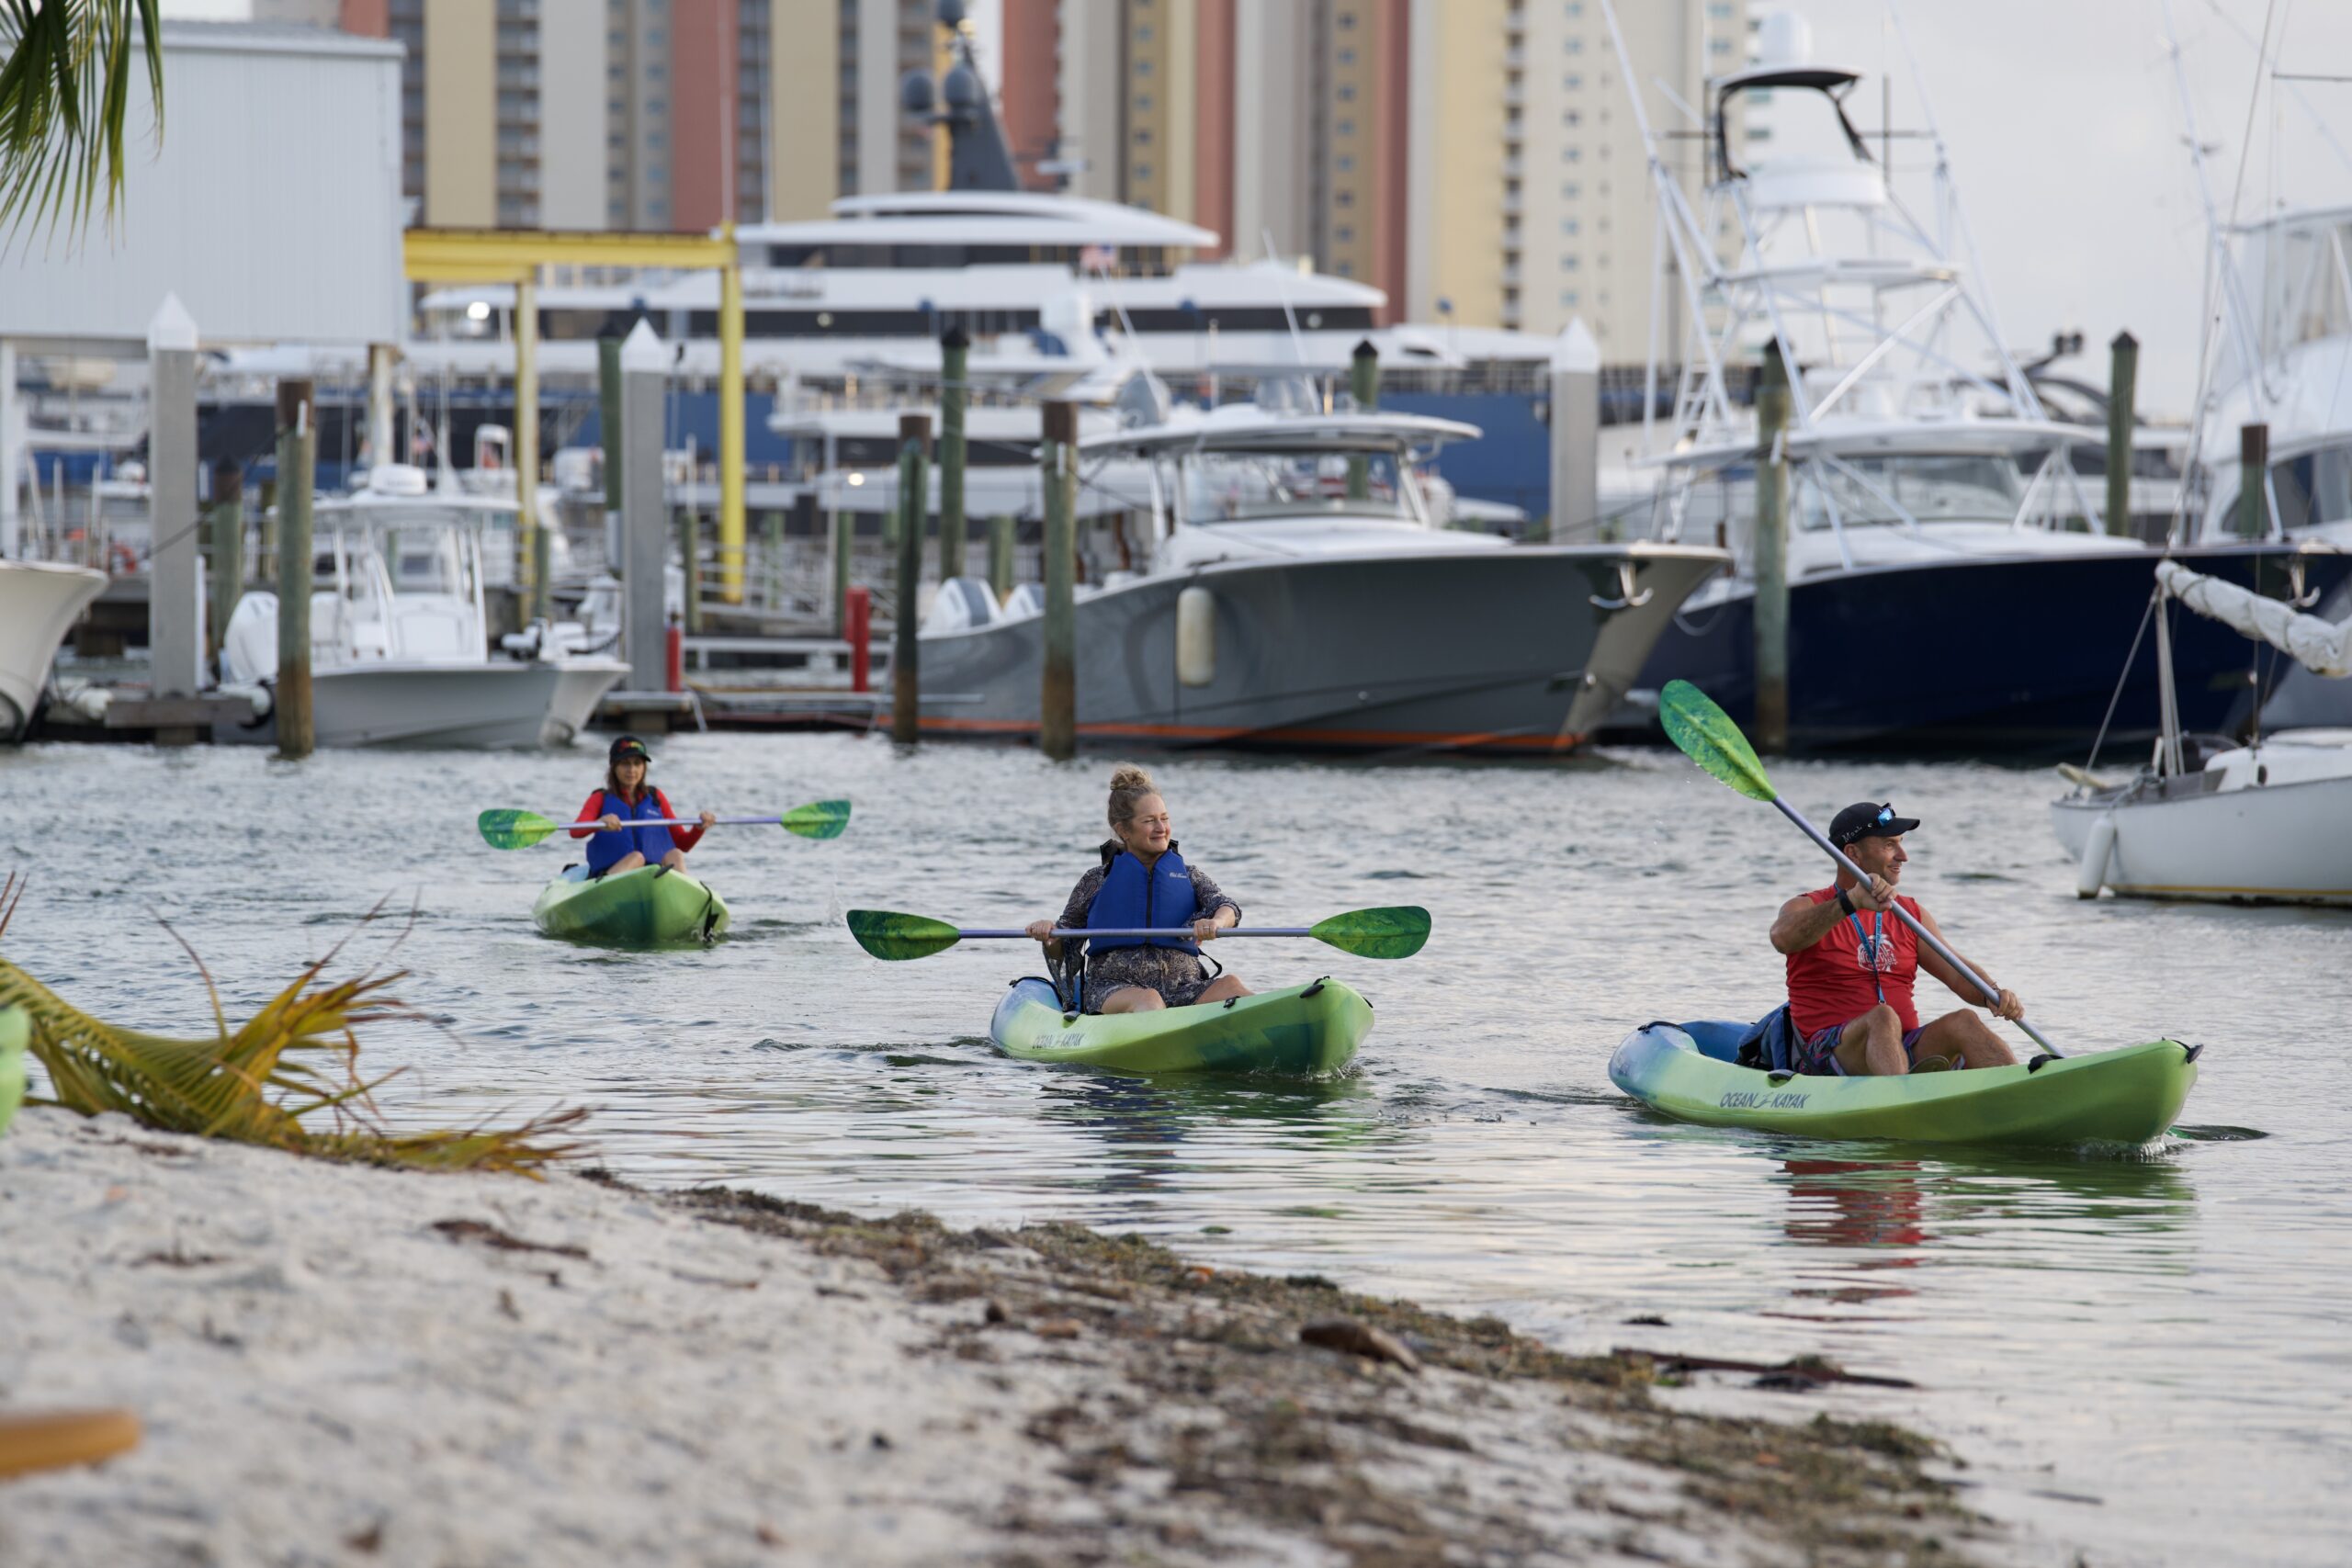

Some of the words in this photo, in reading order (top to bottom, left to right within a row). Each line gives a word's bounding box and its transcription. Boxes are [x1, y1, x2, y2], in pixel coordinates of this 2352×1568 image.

[1061, 1032, 1085, 1047] KAYAK
[1720, 1092, 1758, 1108] OCEAN
[1770, 1093, 1811, 1109] KAYAK
